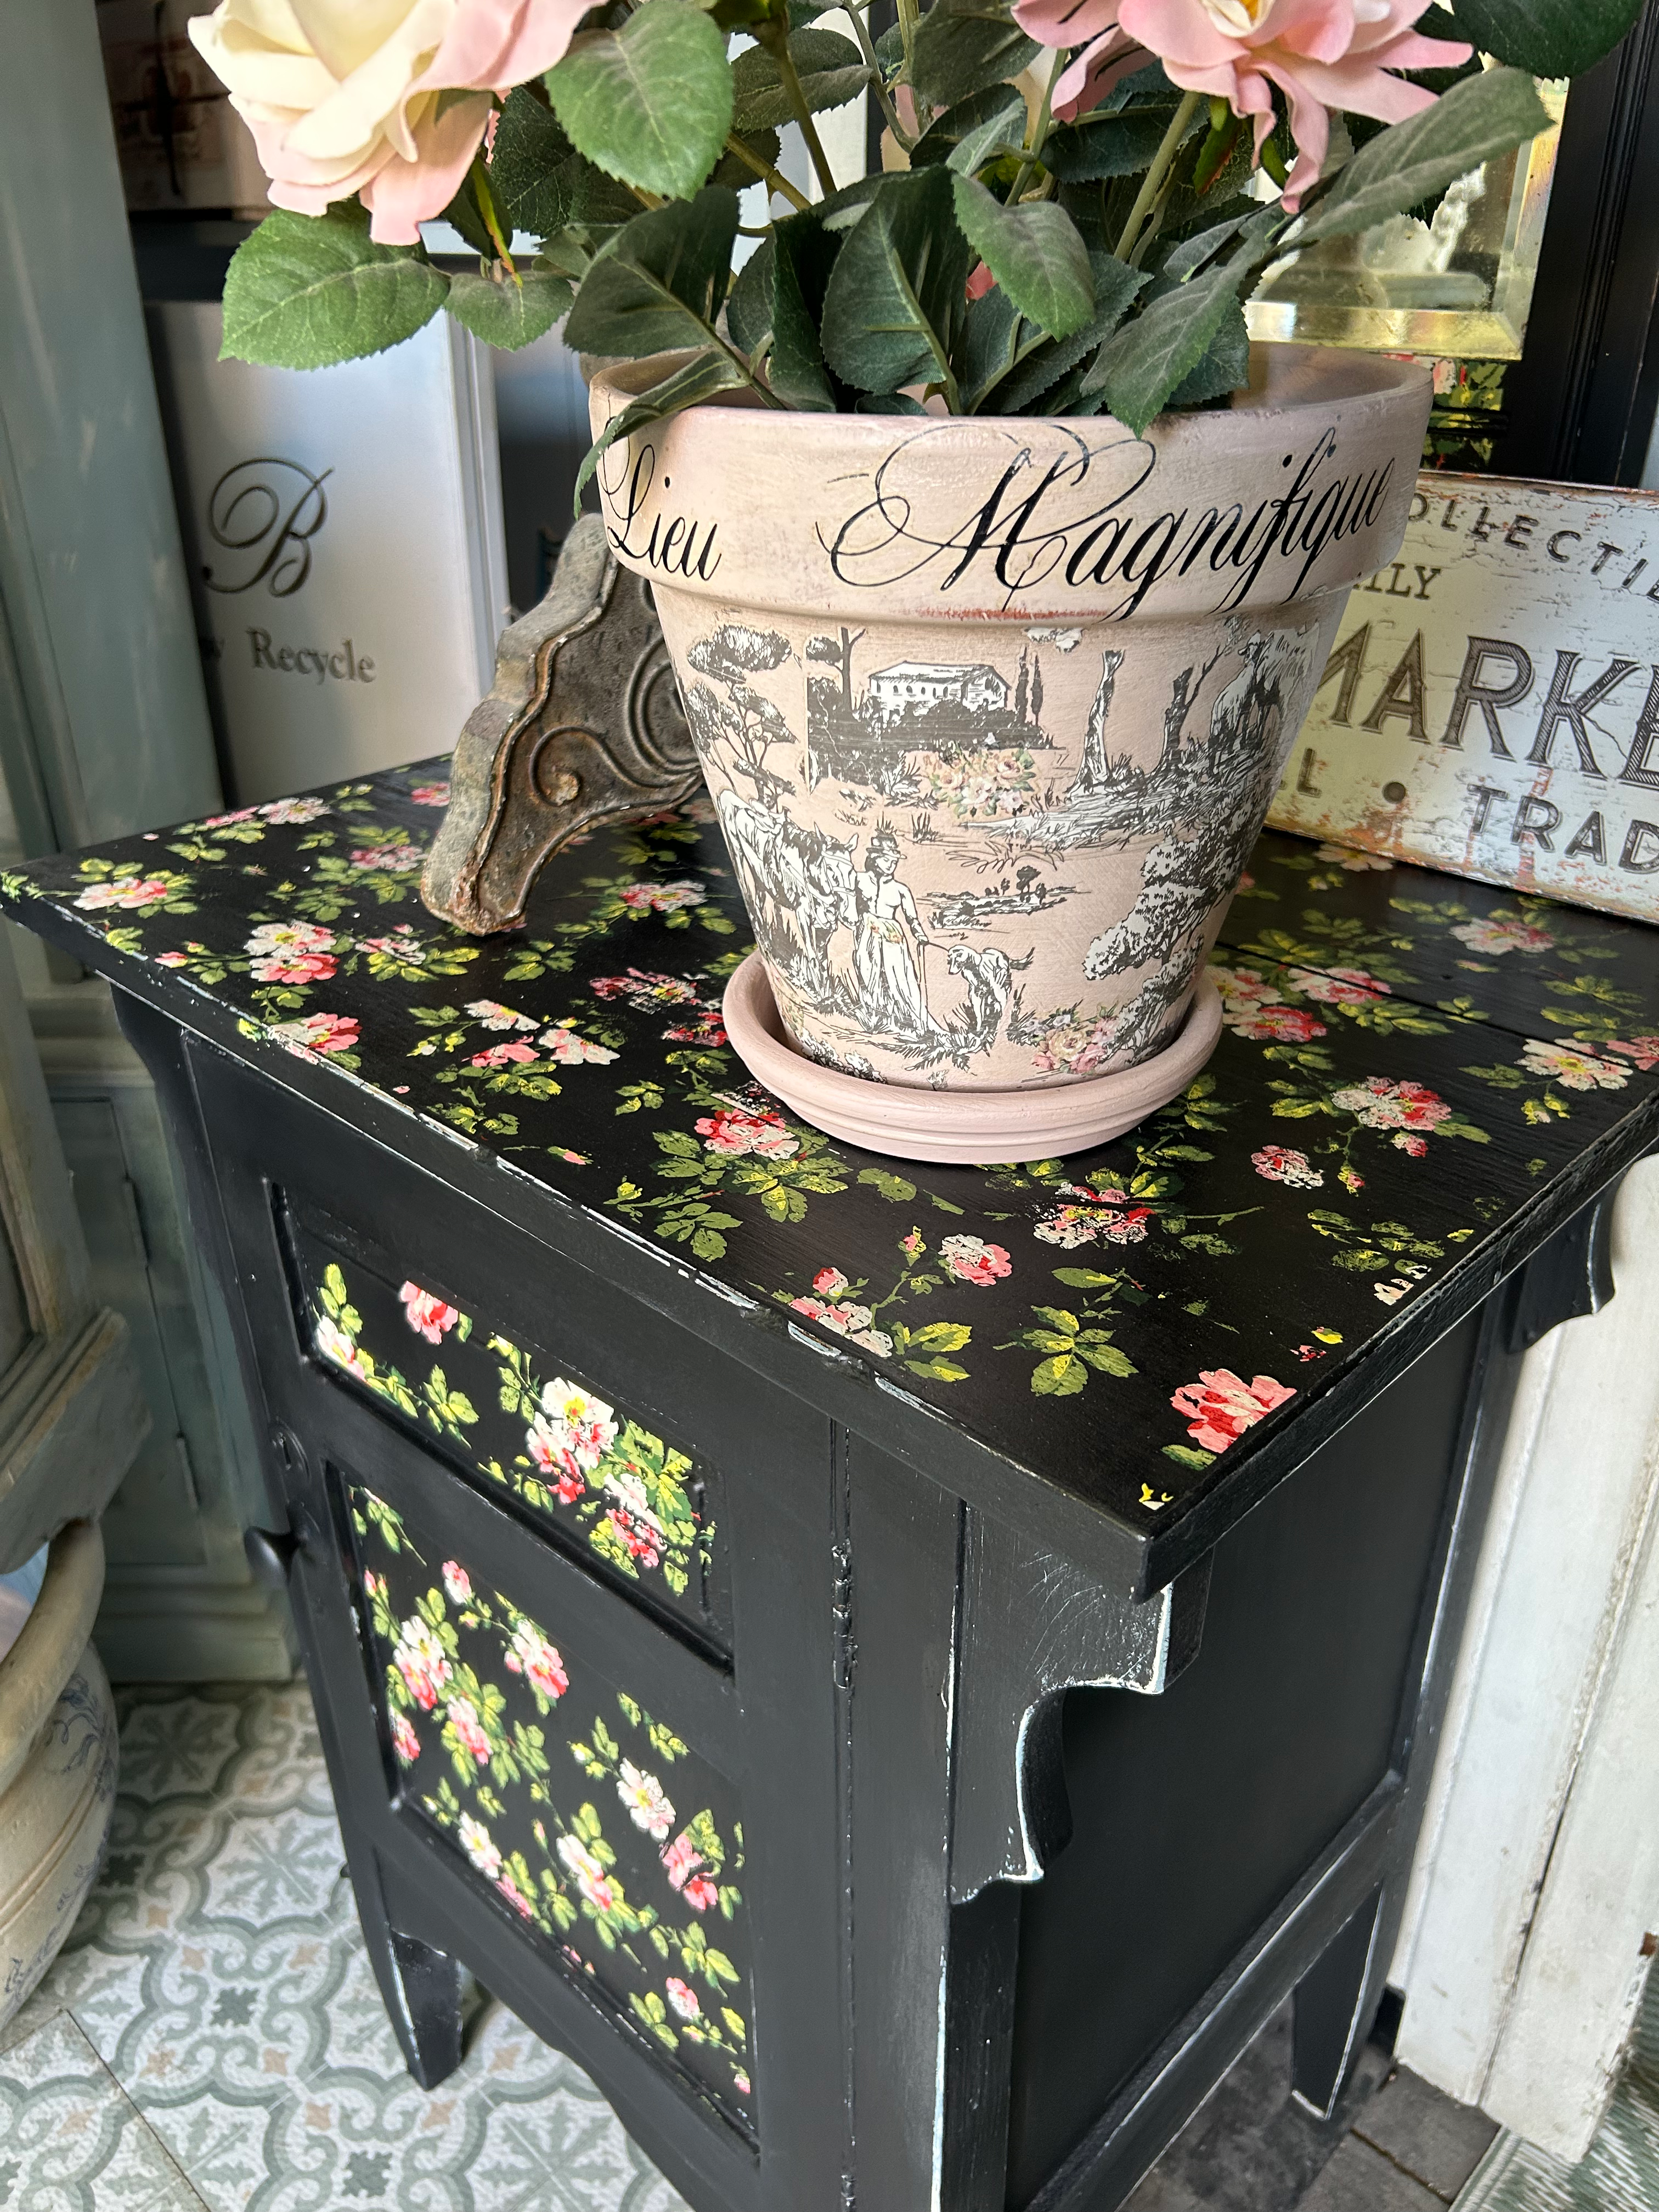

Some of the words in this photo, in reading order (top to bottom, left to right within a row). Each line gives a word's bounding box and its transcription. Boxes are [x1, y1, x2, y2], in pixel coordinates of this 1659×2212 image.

[202, 456, 334, 598] B
[602, 415, 722, 582] Lieu
[816, 424, 1397, 621] Magnifique
[1408, 493, 1659, 604] OLLECTI
[1353, 563, 1442, 600] ILY
[246, 626, 377, 685] Recycle
[1467, 783, 1659, 874] TRAD
